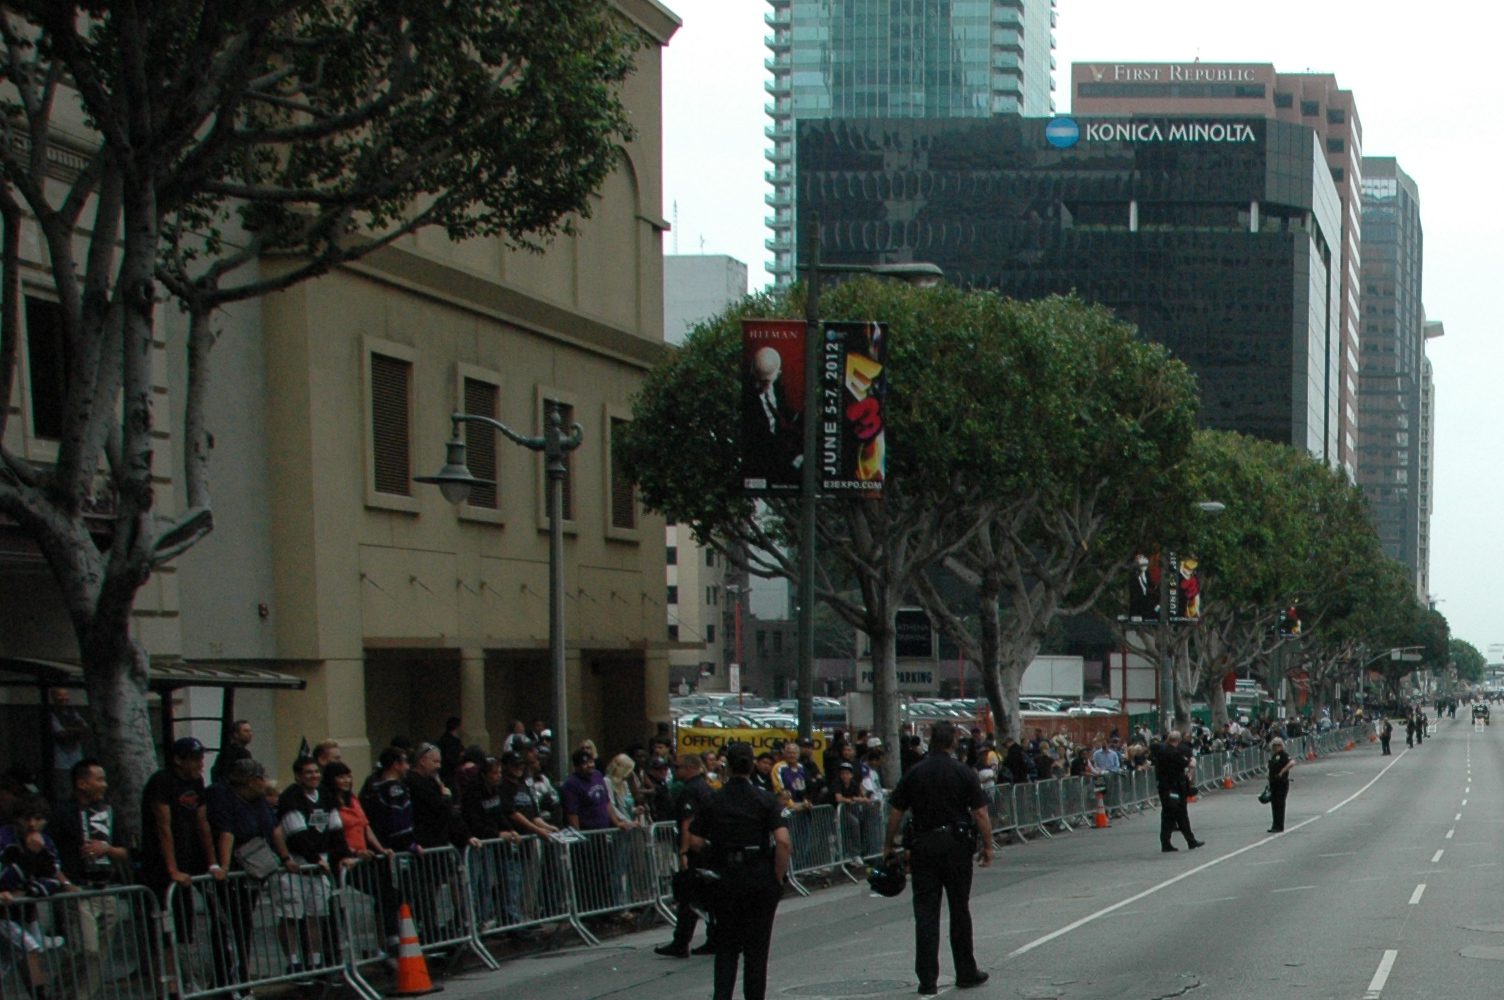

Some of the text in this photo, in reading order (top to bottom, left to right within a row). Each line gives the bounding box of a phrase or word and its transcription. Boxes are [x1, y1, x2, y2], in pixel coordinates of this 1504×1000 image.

[1114, 64, 1255, 82] FIRST REPUBLIC
[1086, 123, 1256, 142] KONICA MINOLTA
[749, 329, 799, 339] HITMAN
[825, 342, 839, 380] 2012
[824, 421, 838, 475] JUNE
[896, 672, 932, 683] PARKING
[682, 735, 743, 749] OFFICIAL
